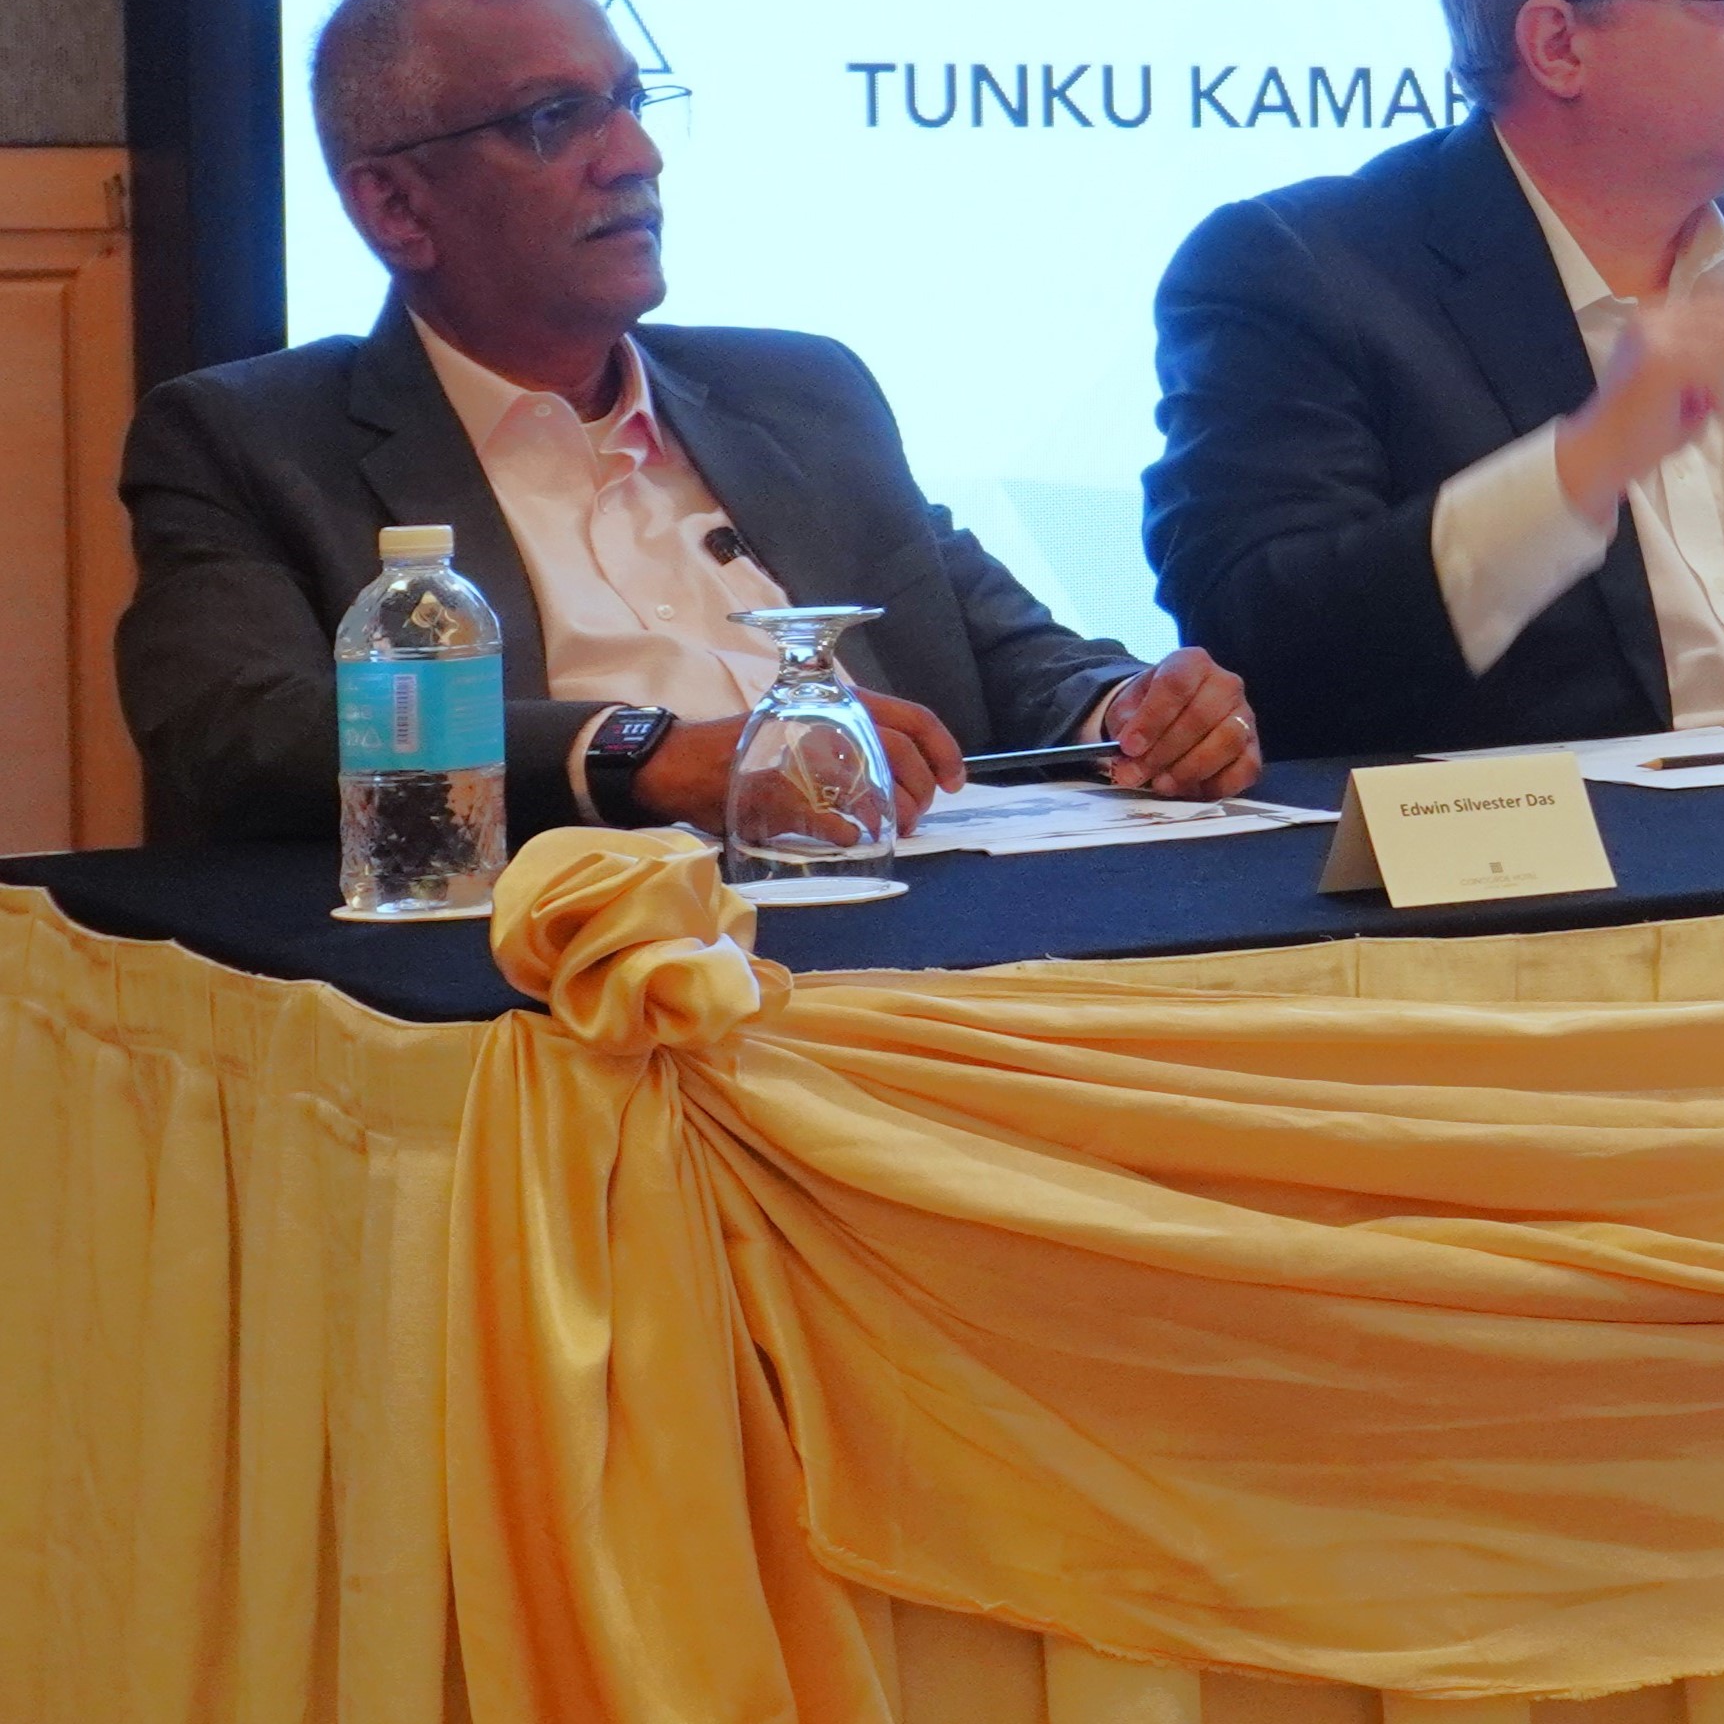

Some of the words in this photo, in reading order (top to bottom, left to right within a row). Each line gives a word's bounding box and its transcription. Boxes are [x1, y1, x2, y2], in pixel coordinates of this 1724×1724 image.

[844, 61, 1153, 130] TUNKU
[1189, 64, 1482, 130] KAMAR
[1400, 800, 1451, 817] Edwin
[1454, 796, 1521, 813] Silvester
[1525, 792, 1556, 807] Das
